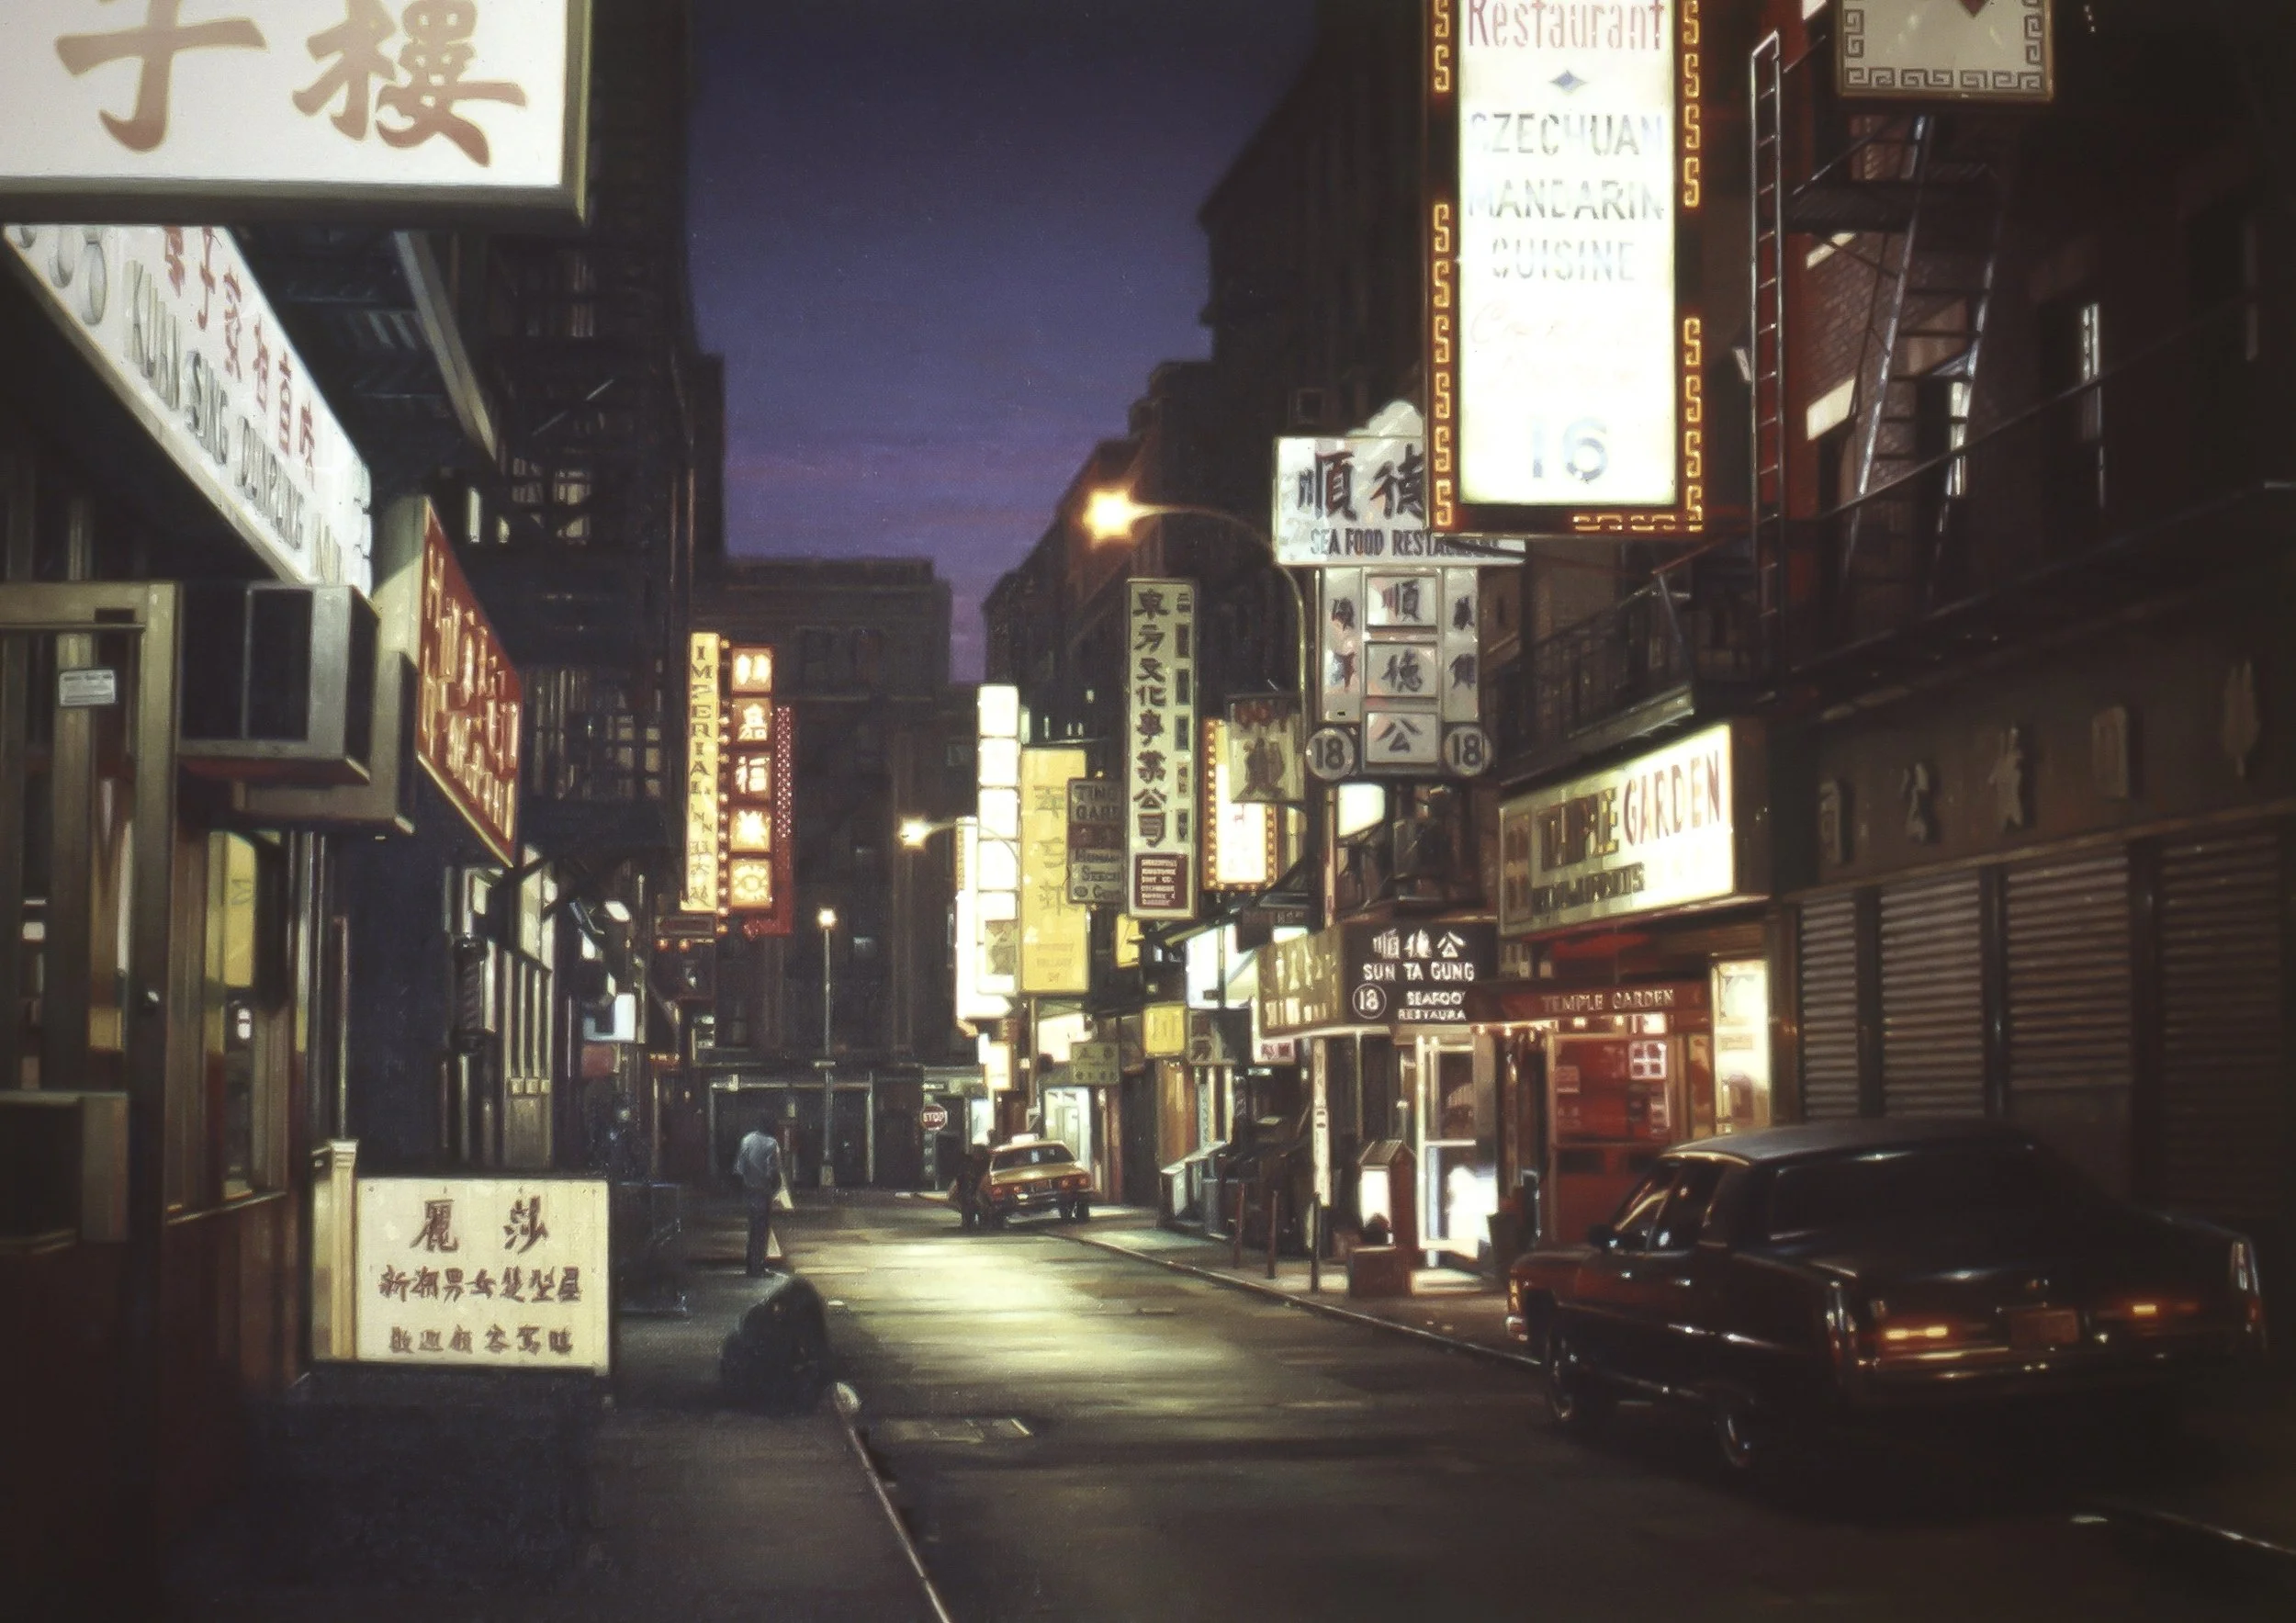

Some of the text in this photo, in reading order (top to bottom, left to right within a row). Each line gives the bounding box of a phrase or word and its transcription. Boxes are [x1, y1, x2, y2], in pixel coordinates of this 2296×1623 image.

[1469, 0, 1665, 50] Restaurant
[1468, 178, 1665, 220] MANDARIN
[1492, 237, 1635, 281] CUISINE
[1532, 416, 1608, 483] 16
[1311, 528, 1340, 557] SEA
[1345, 528, 1385, 558] FOOD
[1315, 737, 1345, 771] 18
[1453, 734, 1482, 767] 18
[1623, 750, 1721, 846] GARDEN
[1363, 962, 1396, 982] SUN
[1402, 962, 1424, 981] TA
[1430, 962, 1475, 982] GUNG
[1406, 989, 1466, 1007] SEAFOO
[1544, 988, 1675, 1011] TEMPLE GARDEN
[923, 1111, 944, 1122] STOP
